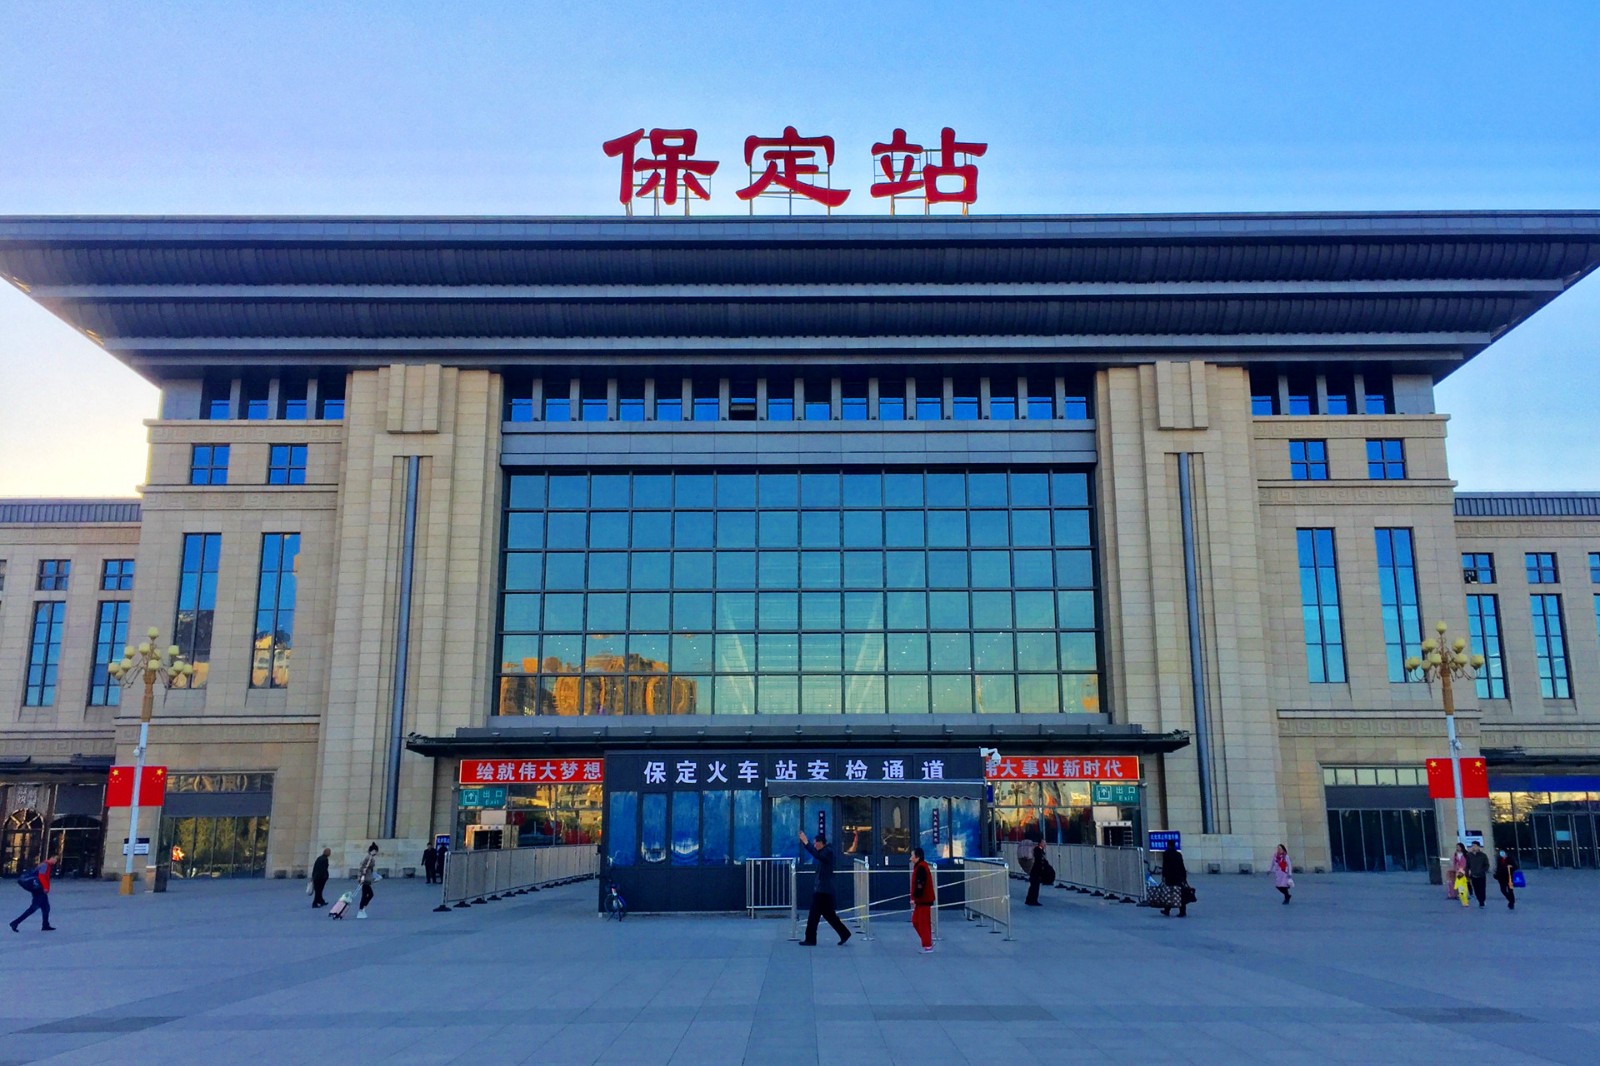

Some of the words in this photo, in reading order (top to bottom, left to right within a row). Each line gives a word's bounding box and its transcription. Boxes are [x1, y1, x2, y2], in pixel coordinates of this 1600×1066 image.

[602, 126, 988, 206] 保定站
[476, 761, 602, 781] 绘就伟大梦想
[643, 759, 945, 784] 保定火车站安检通道
[482, 789, 503, 799] 出口
[1115, 786, 1136, 794] 出口
